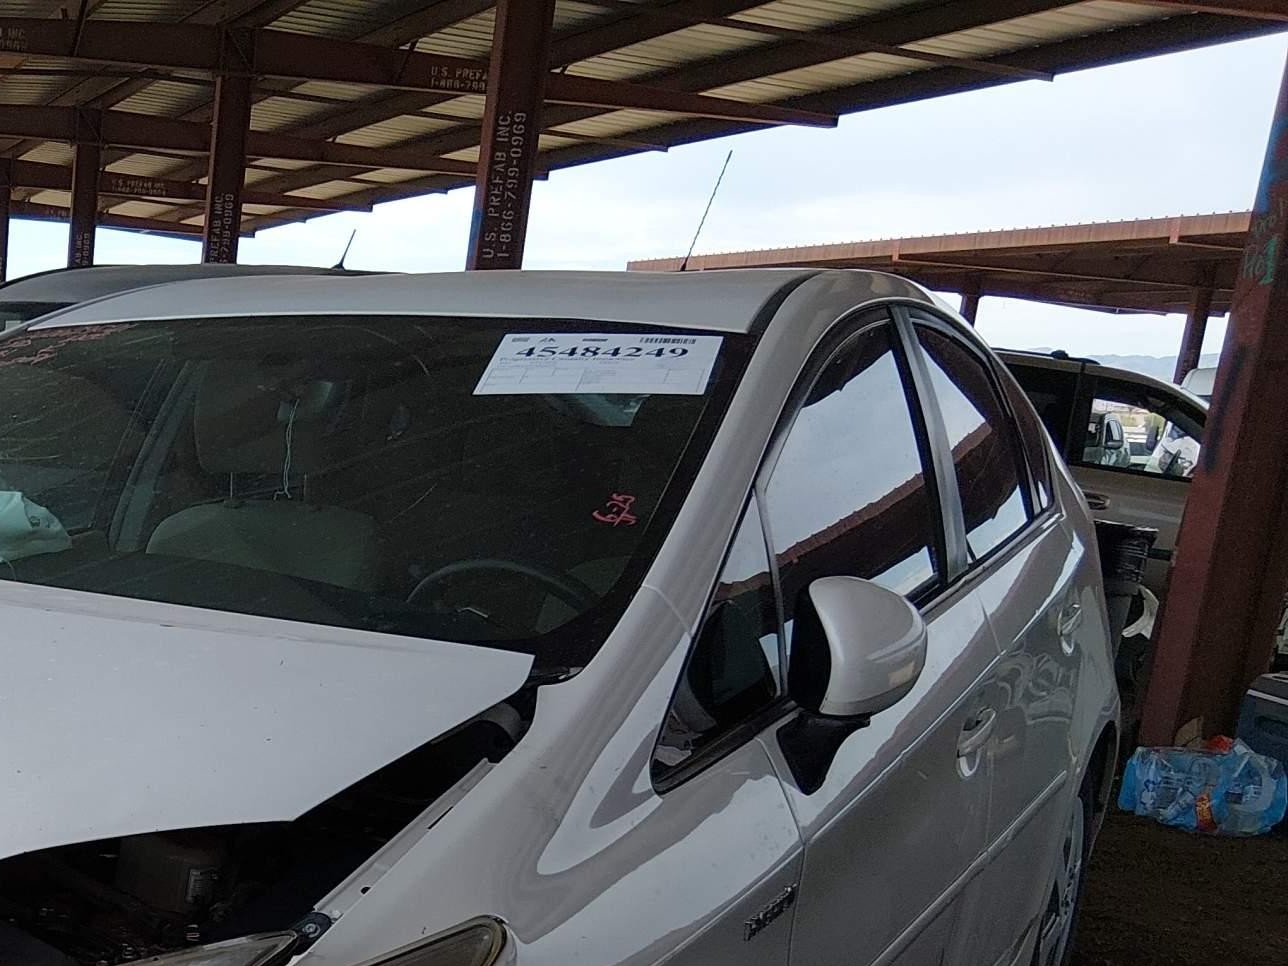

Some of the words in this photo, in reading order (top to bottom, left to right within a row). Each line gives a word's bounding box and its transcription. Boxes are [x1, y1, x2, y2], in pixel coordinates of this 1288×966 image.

[496, 110, 512, 142] INC.
[488, 151, 507, 217] PREFAB
[497, 112, 527, 257] 1-866-799-0969
[482, 227, 498, 258] U.S.
[516, 345, 689, 359] 45484249
